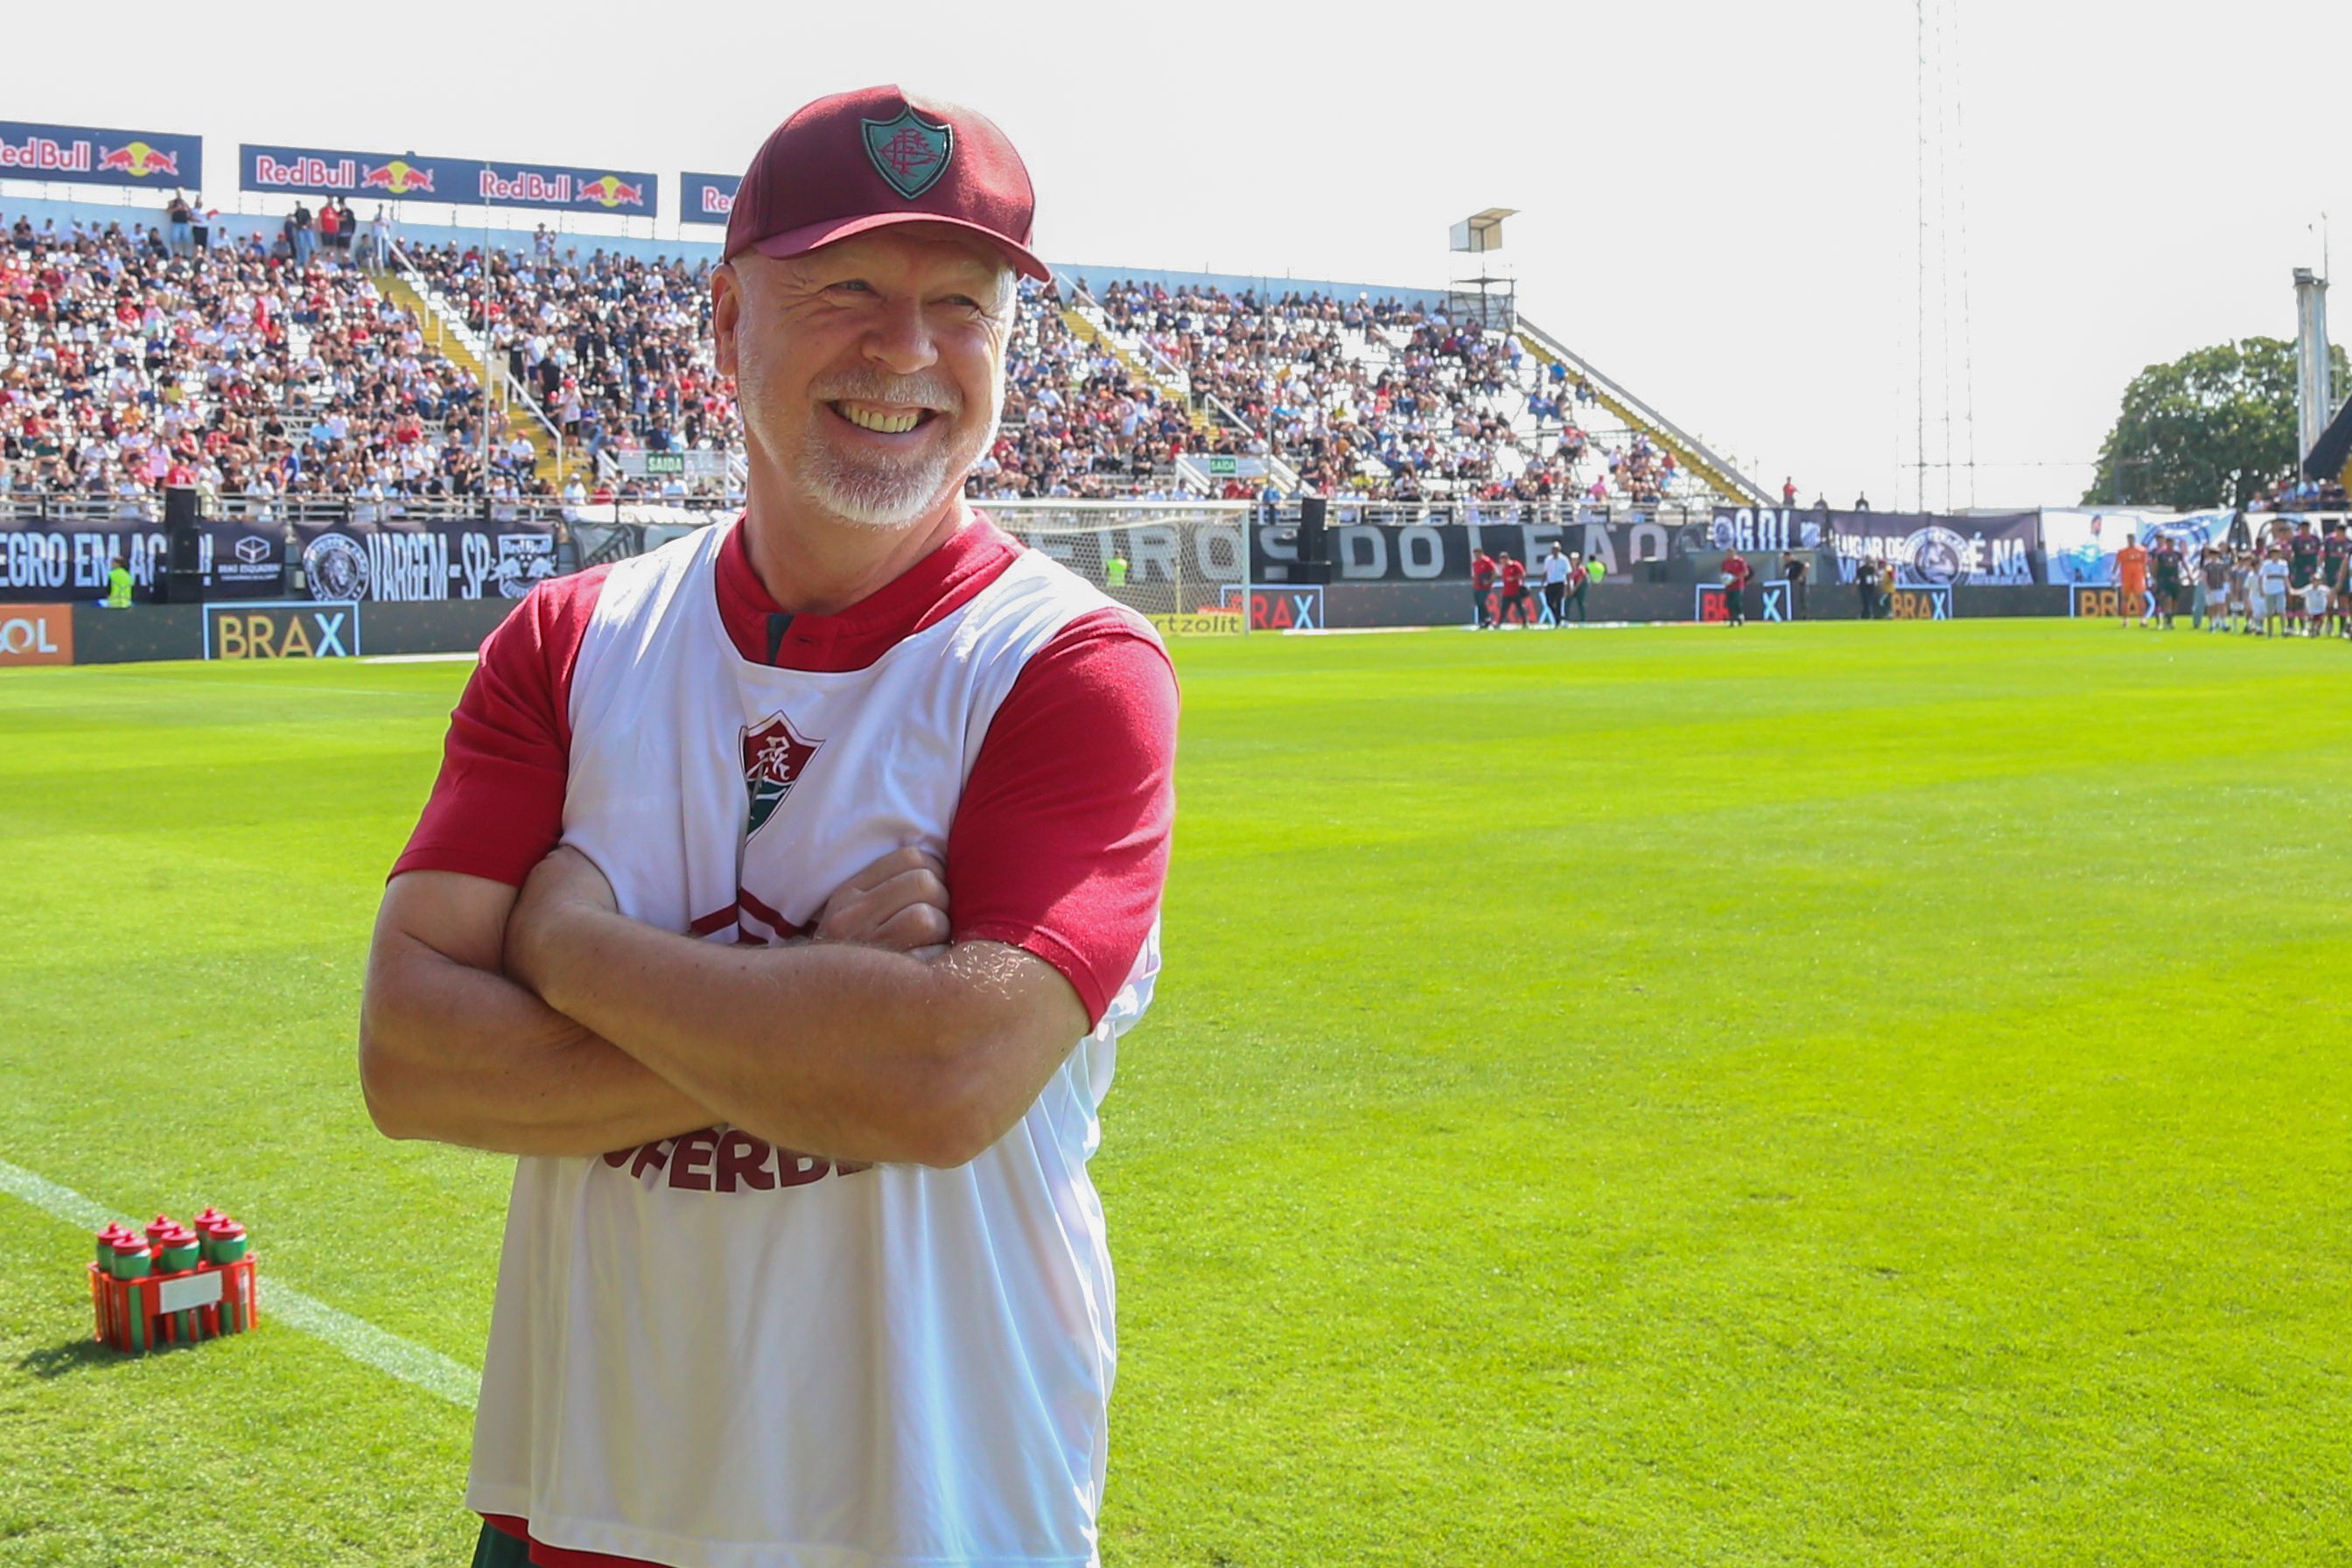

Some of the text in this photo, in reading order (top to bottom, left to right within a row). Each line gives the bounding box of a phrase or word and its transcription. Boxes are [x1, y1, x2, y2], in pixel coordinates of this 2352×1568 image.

[702, 186, 736, 214] Re
[1339, 525, 1445, 579] DO
[1892, 592, 1947, 620] BRAX
[218, 612, 347, 658] BRAX
